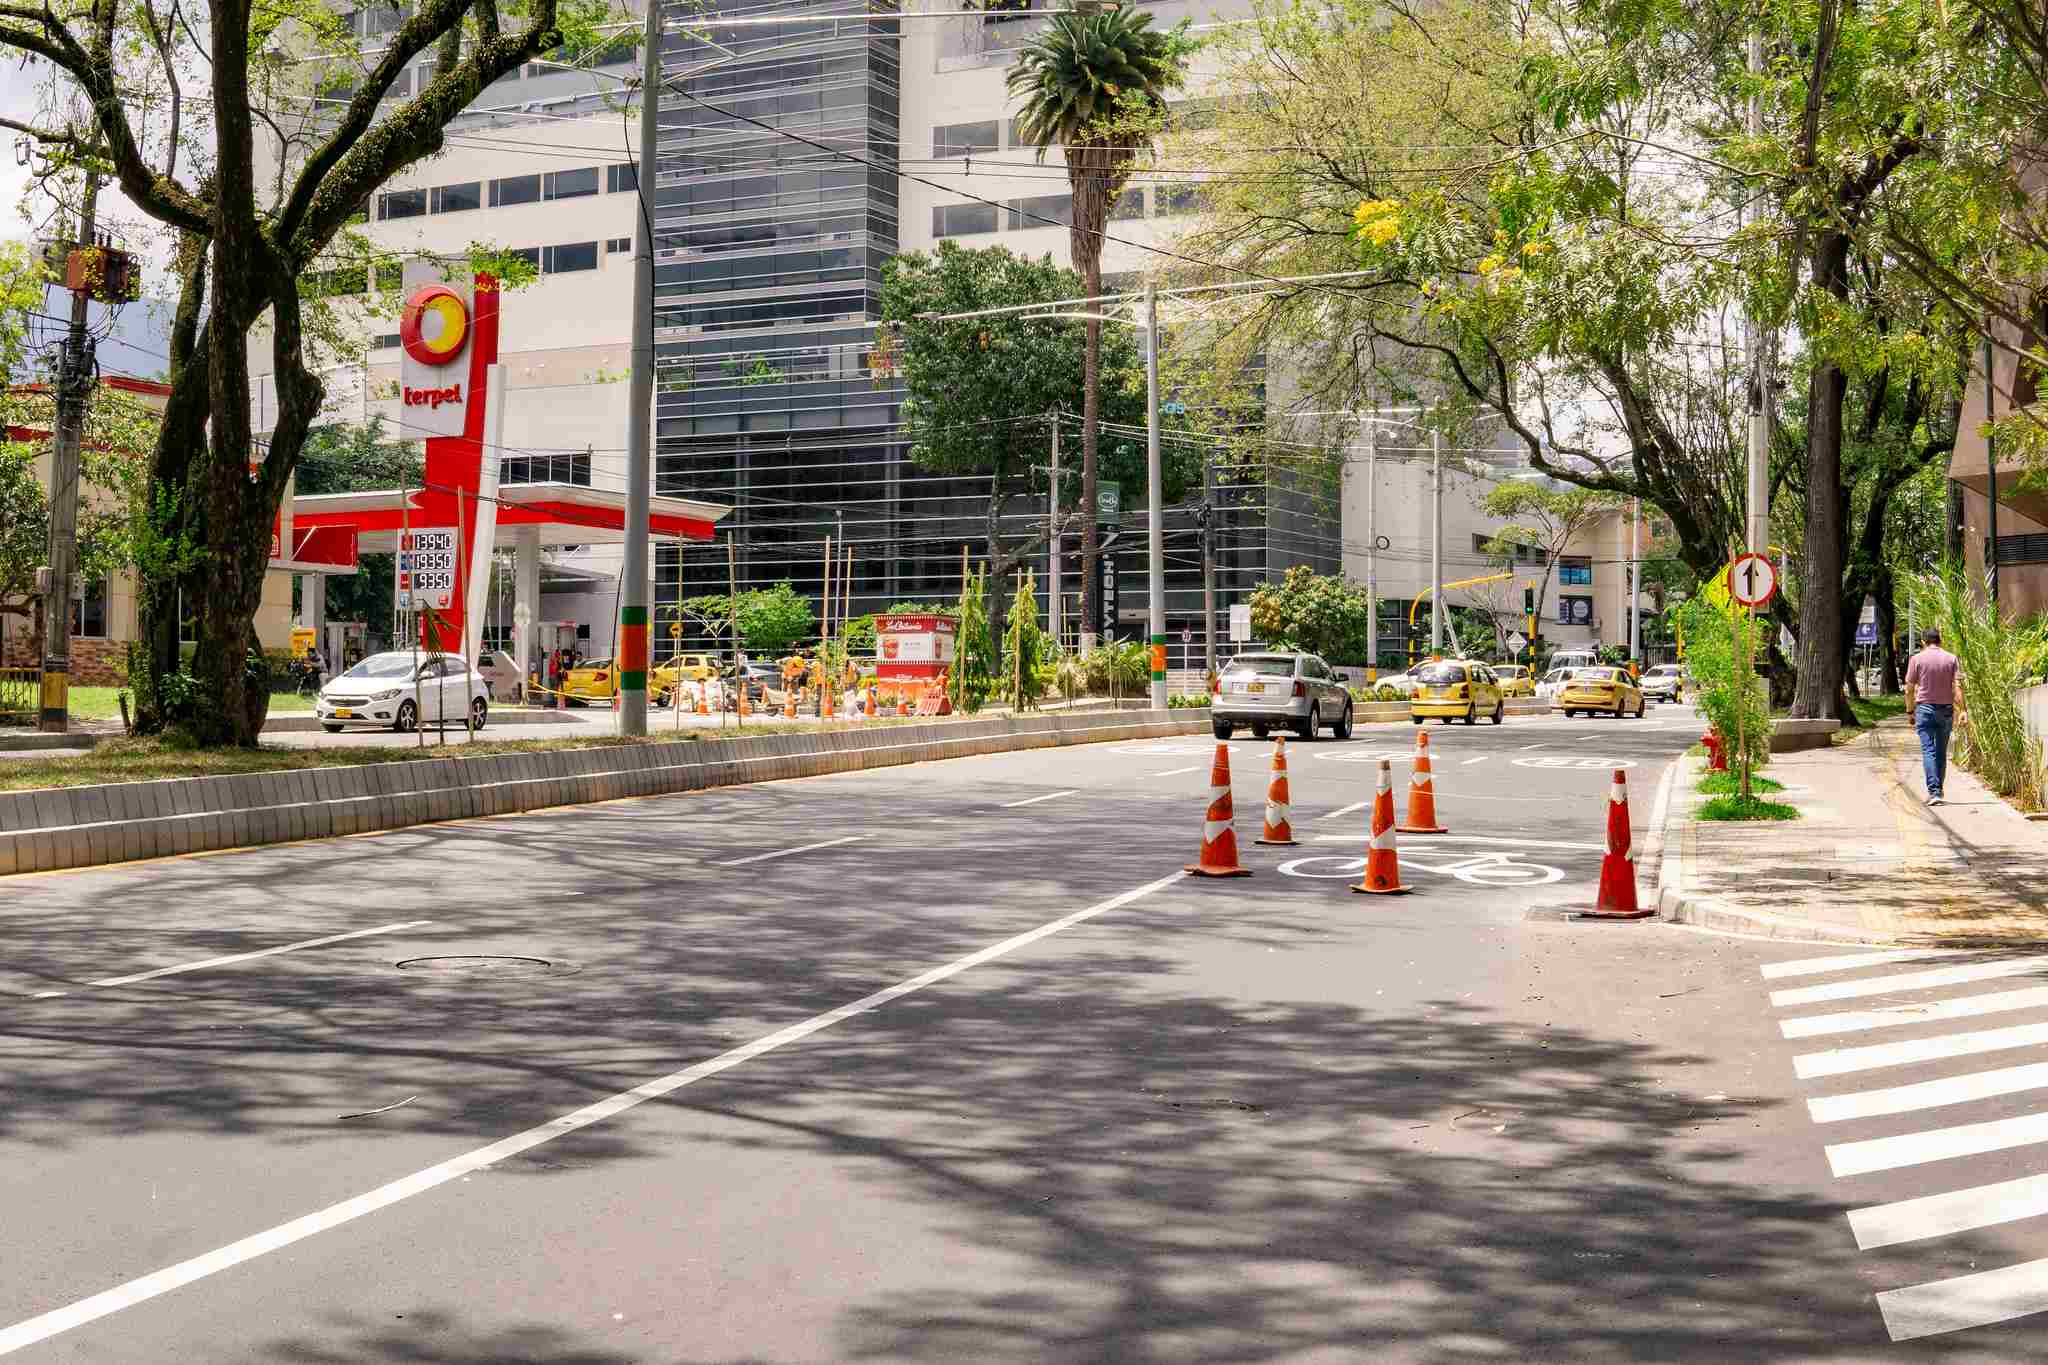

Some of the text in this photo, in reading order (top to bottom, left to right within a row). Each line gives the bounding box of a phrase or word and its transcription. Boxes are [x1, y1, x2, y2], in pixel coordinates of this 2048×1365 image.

[403, 384, 463, 410] terpel
[416, 535, 452, 550] 13940
[416, 554, 452, 569] 19350
[420, 573, 451, 589] 9350
[1103, 561, 1115, 641] DYTECH
